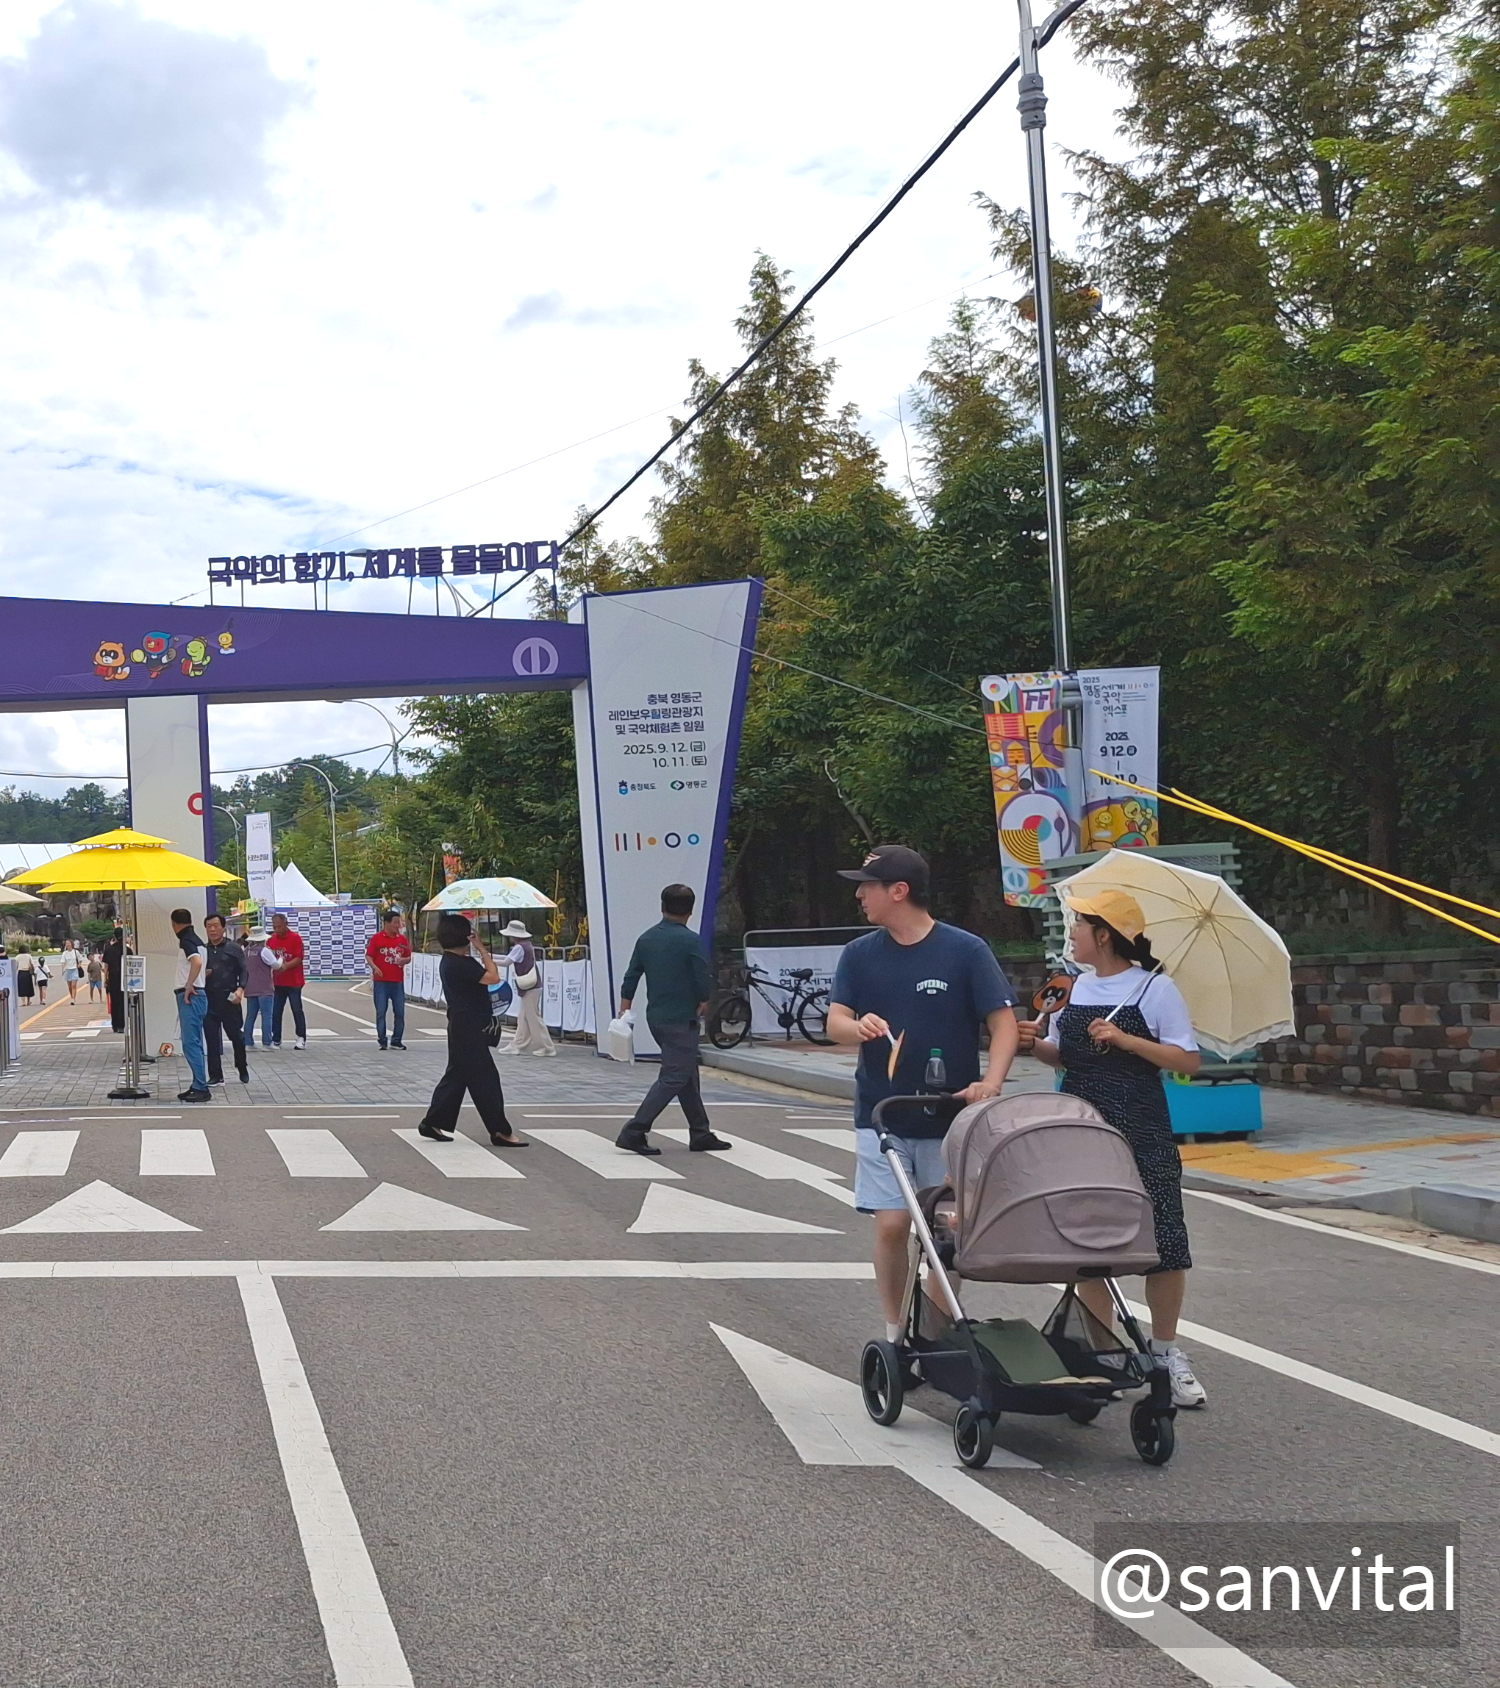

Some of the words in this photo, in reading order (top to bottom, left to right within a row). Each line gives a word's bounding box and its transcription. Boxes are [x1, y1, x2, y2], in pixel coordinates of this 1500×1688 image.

[207, 554, 285, 586] 국악의
[292, 551, 354, 583] 향기,
[364, 546, 444, 578] 세계를
[452, 540, 560, 576] 물들이다
[647, 693, 669, 705] 충북
[670, 692, 702, 704] 영동군
[608, 706, 703, 722] 레인보우힐링관광지
[615, 724, 626, 736] 및
[628, 721, 681, 734] 국악체험촌
[683, 720, 705, 732] 일원
